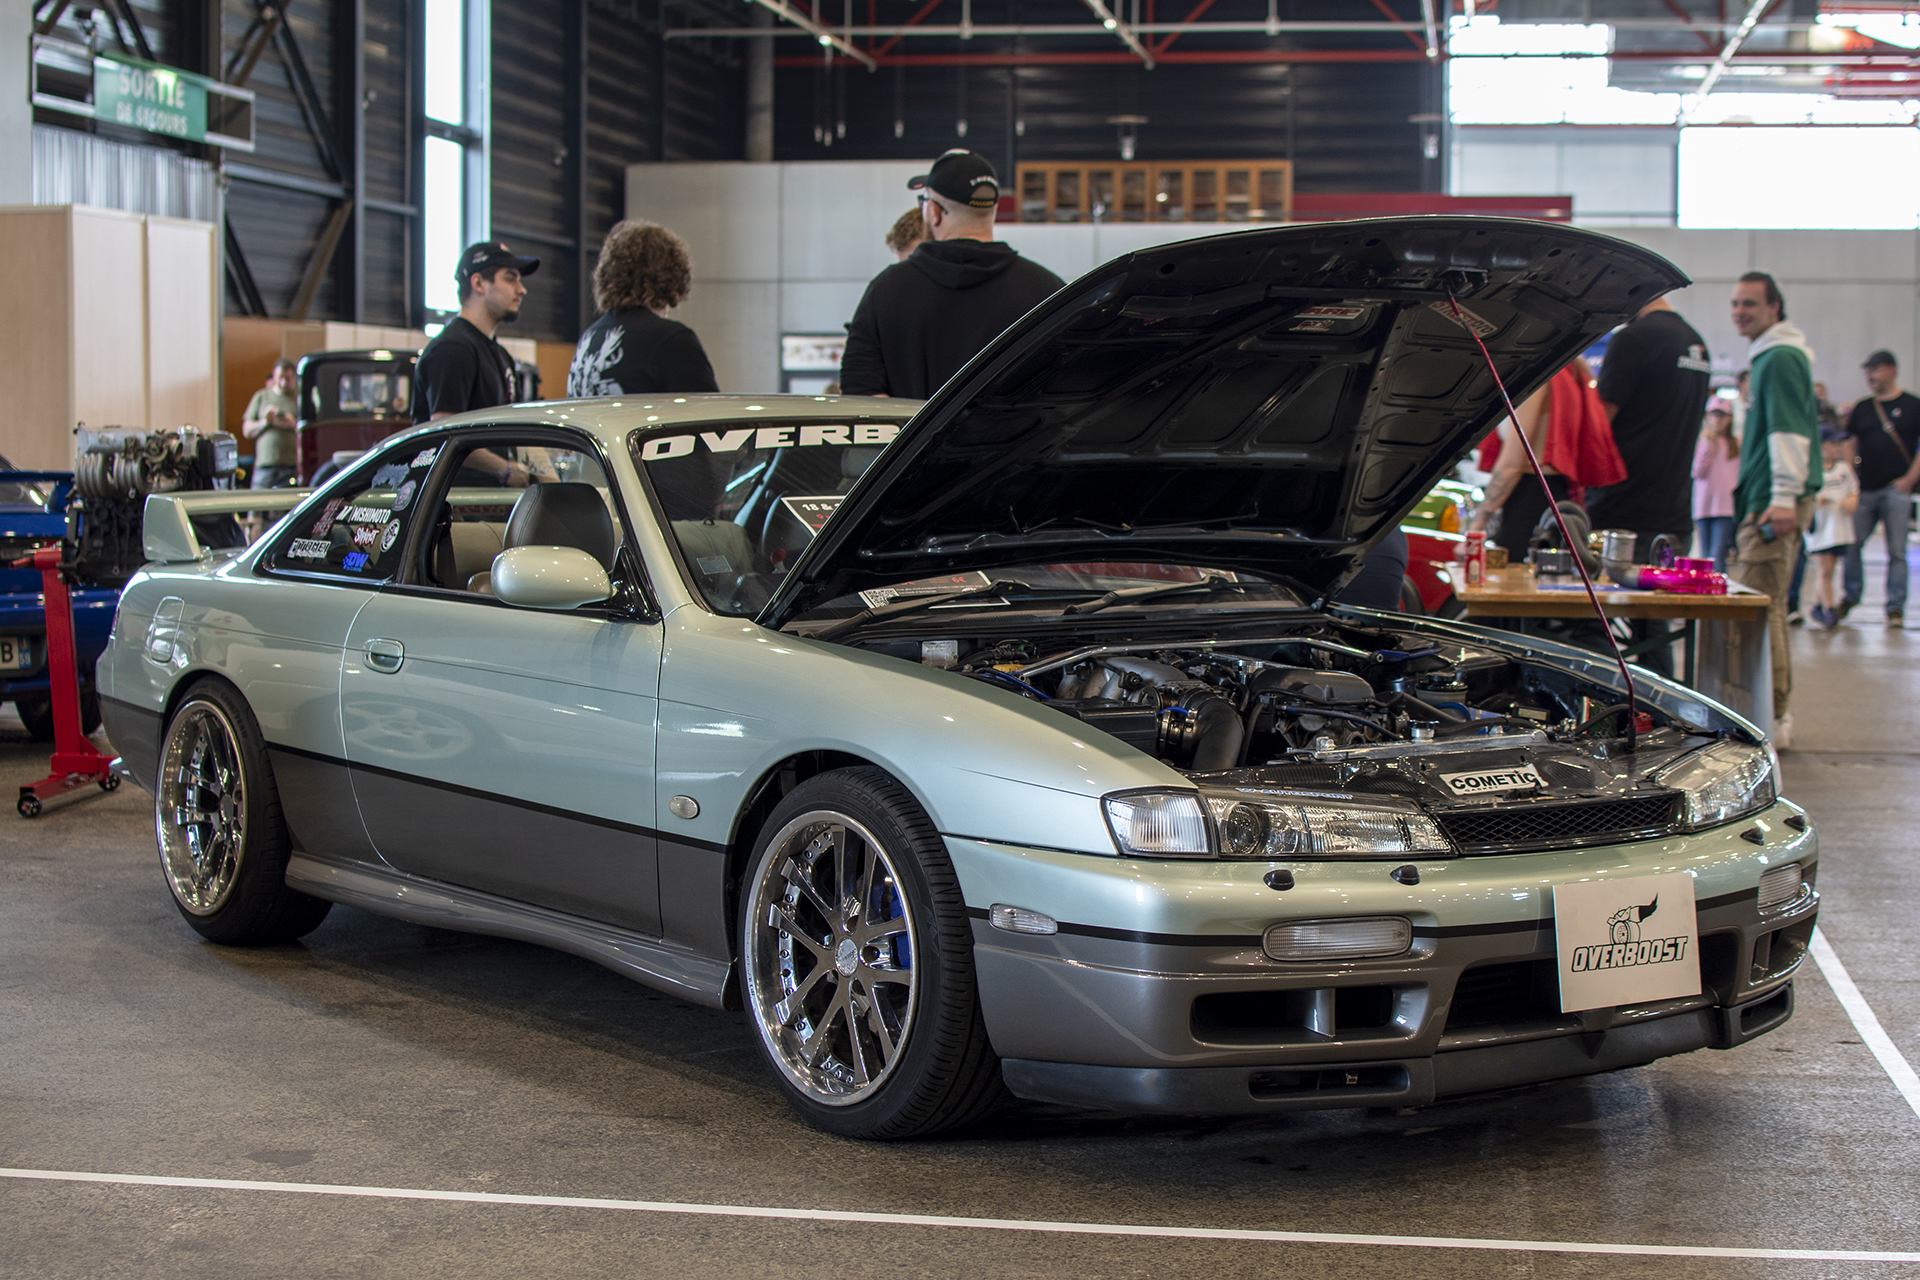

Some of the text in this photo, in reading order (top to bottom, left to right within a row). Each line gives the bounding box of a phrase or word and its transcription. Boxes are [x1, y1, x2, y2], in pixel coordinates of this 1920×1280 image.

[118, 64, 185, 109] SORTIE
[116, 101, 188, 136] DE SECOURS
[351, 507, 391, 524] MISHIMOTO
[843, 784, 882, 812] ZEON
[1571, 935, 1689, 973] OVERBOOST
